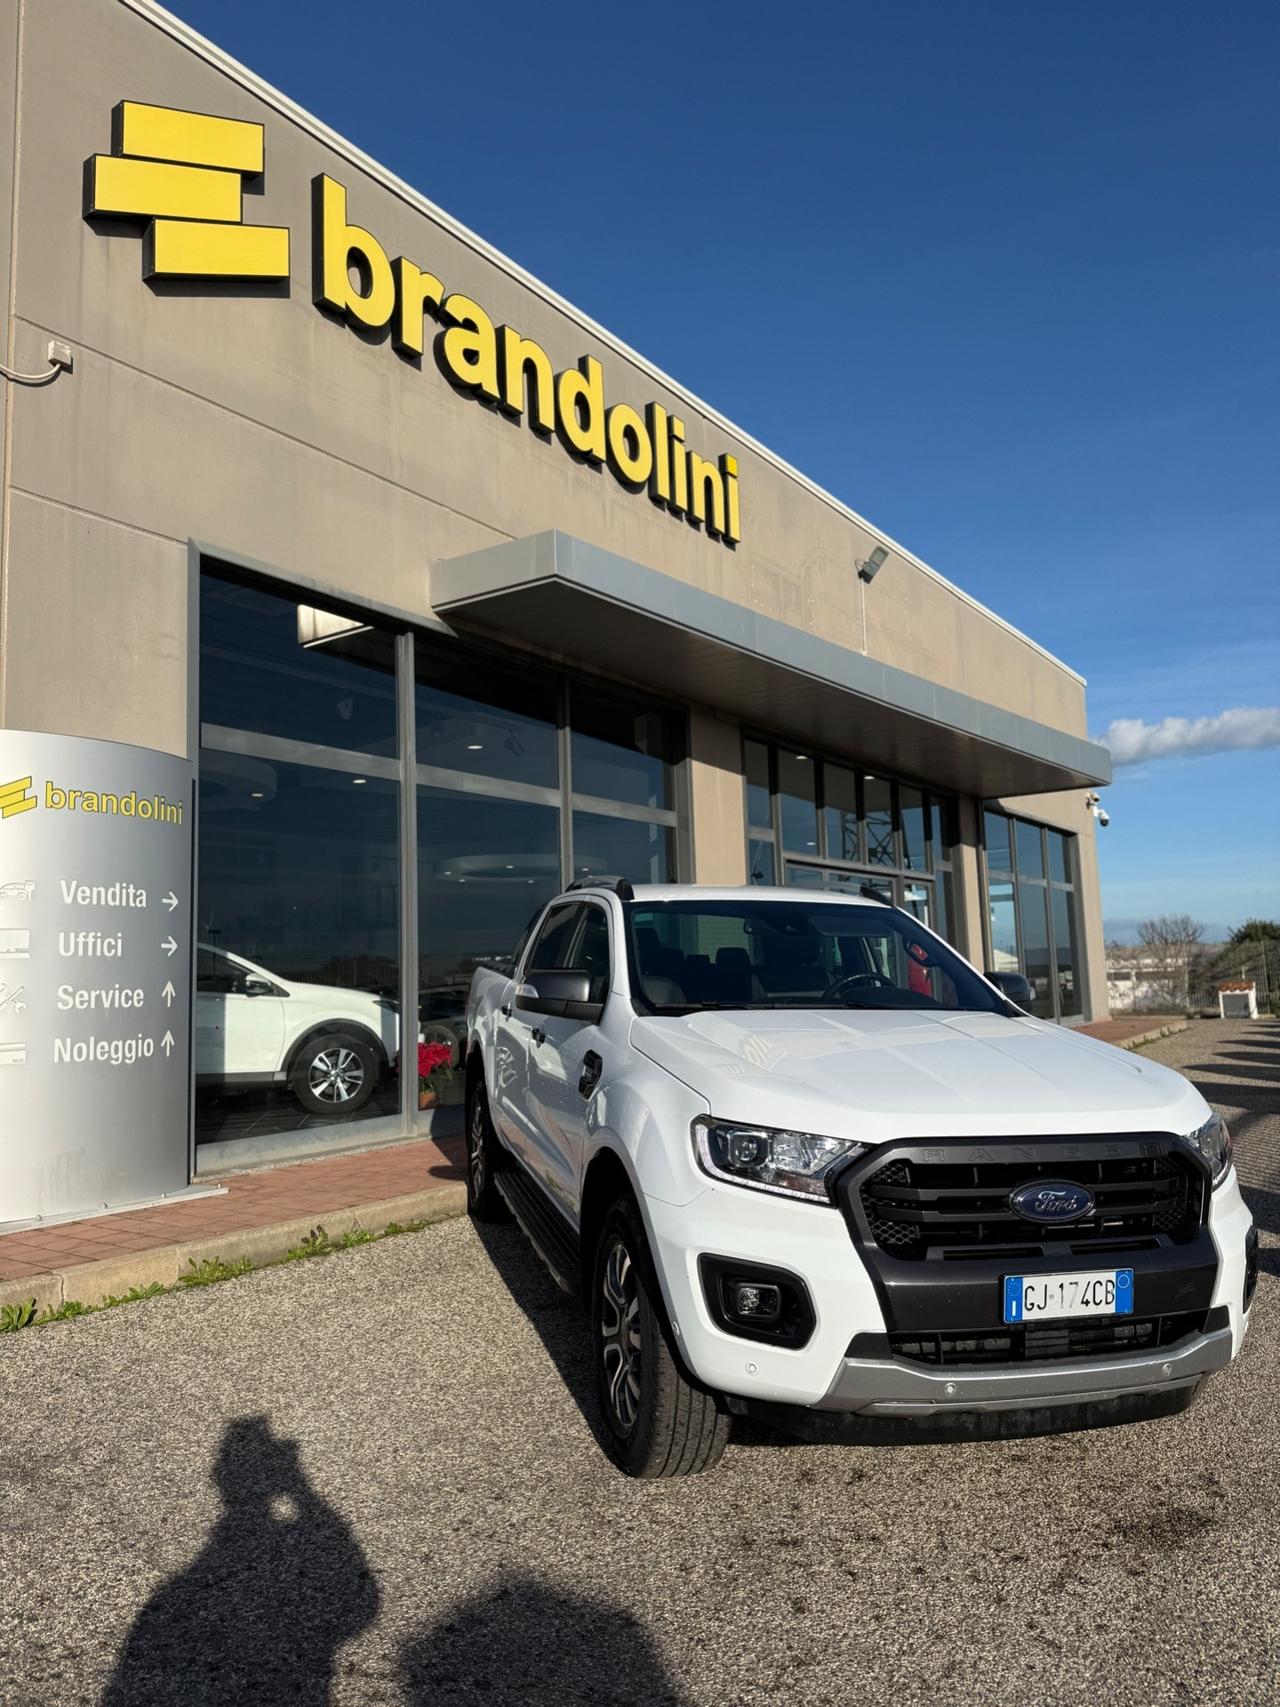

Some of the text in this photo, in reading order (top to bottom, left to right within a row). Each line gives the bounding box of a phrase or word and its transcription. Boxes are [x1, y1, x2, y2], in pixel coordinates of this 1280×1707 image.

[312, 173, 741, 544] brandolini
[45, 780, 184, 824] brandolini
[60, 880, 147, 907] Vendita
[58, 932, 123, 957] Uffici
[57, 984, 145, 1010] Service
[53, 1034, 154, 1065] Noleggio
[1035, 1190, 1077, 1212] Ford
